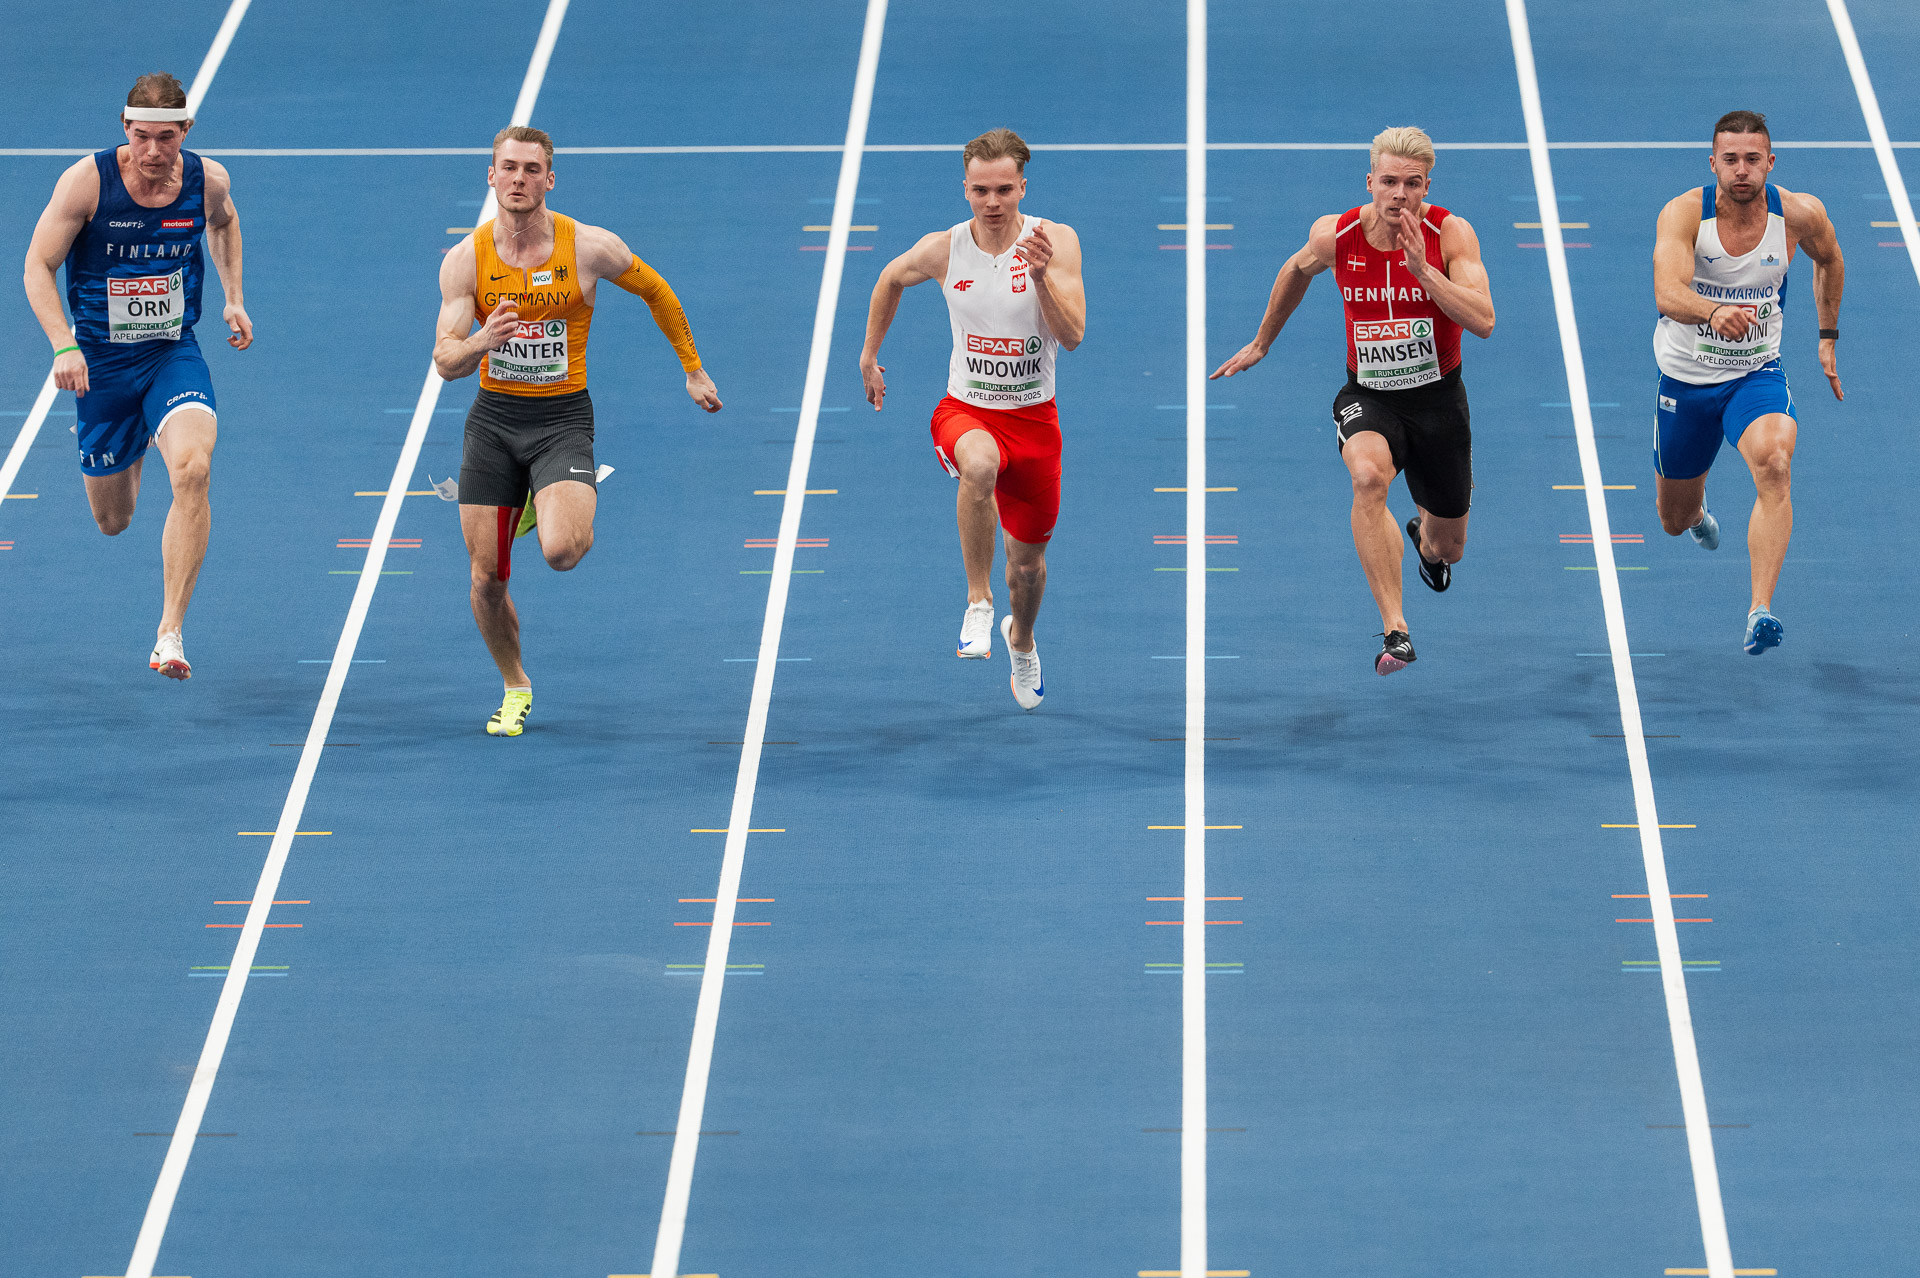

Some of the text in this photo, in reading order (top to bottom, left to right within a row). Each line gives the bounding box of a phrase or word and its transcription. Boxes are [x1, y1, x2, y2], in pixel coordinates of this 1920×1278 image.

[162, 220, 194, 228] motonet
[106, 243, 192, 259] FINLAND
[1009, 262, 1028, 272] ORLEN
[532, 274, 552, 283] WGV
[953, 280, 975, 292] 4F
[110, 279, 168, 295] SPAR
[1696, 282, 1774, 300] SAN MARINO
[127, 297, 171, 317] ÖRN
[131, 322, 149, 331] RUN
[148, 320, 174, 331] CLEAN
[515, 323, 543, 338] AR
[1356, 322, 1410, 340] SPAR
[1697, 321, 1768, 344] SANVINI
[113, 328, 181, 341] APELDOORN 20
[968, 336, 1023, 354] SPAR
[1357, 340, 1433, 364] HANSEN
[1715, 347, 1731, 355] RUN
[1732, 348, 1756, 356] CLEAN
[506, 362, 522, 372] RUN
[966, 356, 1042, 378] WDOWIK
[1695, 354, 1752, 367] APELDOORN
[491, 367, 543, 382] APELDOORN
[1377, 369, 1393, 378] RUN
[1394, 366, 1420, 376] CLEAN
[984, 382, 1000, 391] RUN
[1001, 384, 1026, 392] CLEAN
[1361, 371, 1438, 389] APELDOORN 2025
[166, 391, 199, 406] CRAFT
[966, 390, 1042, 402] APELDOORN 2025
[79, 449, 115, 468] FIN
